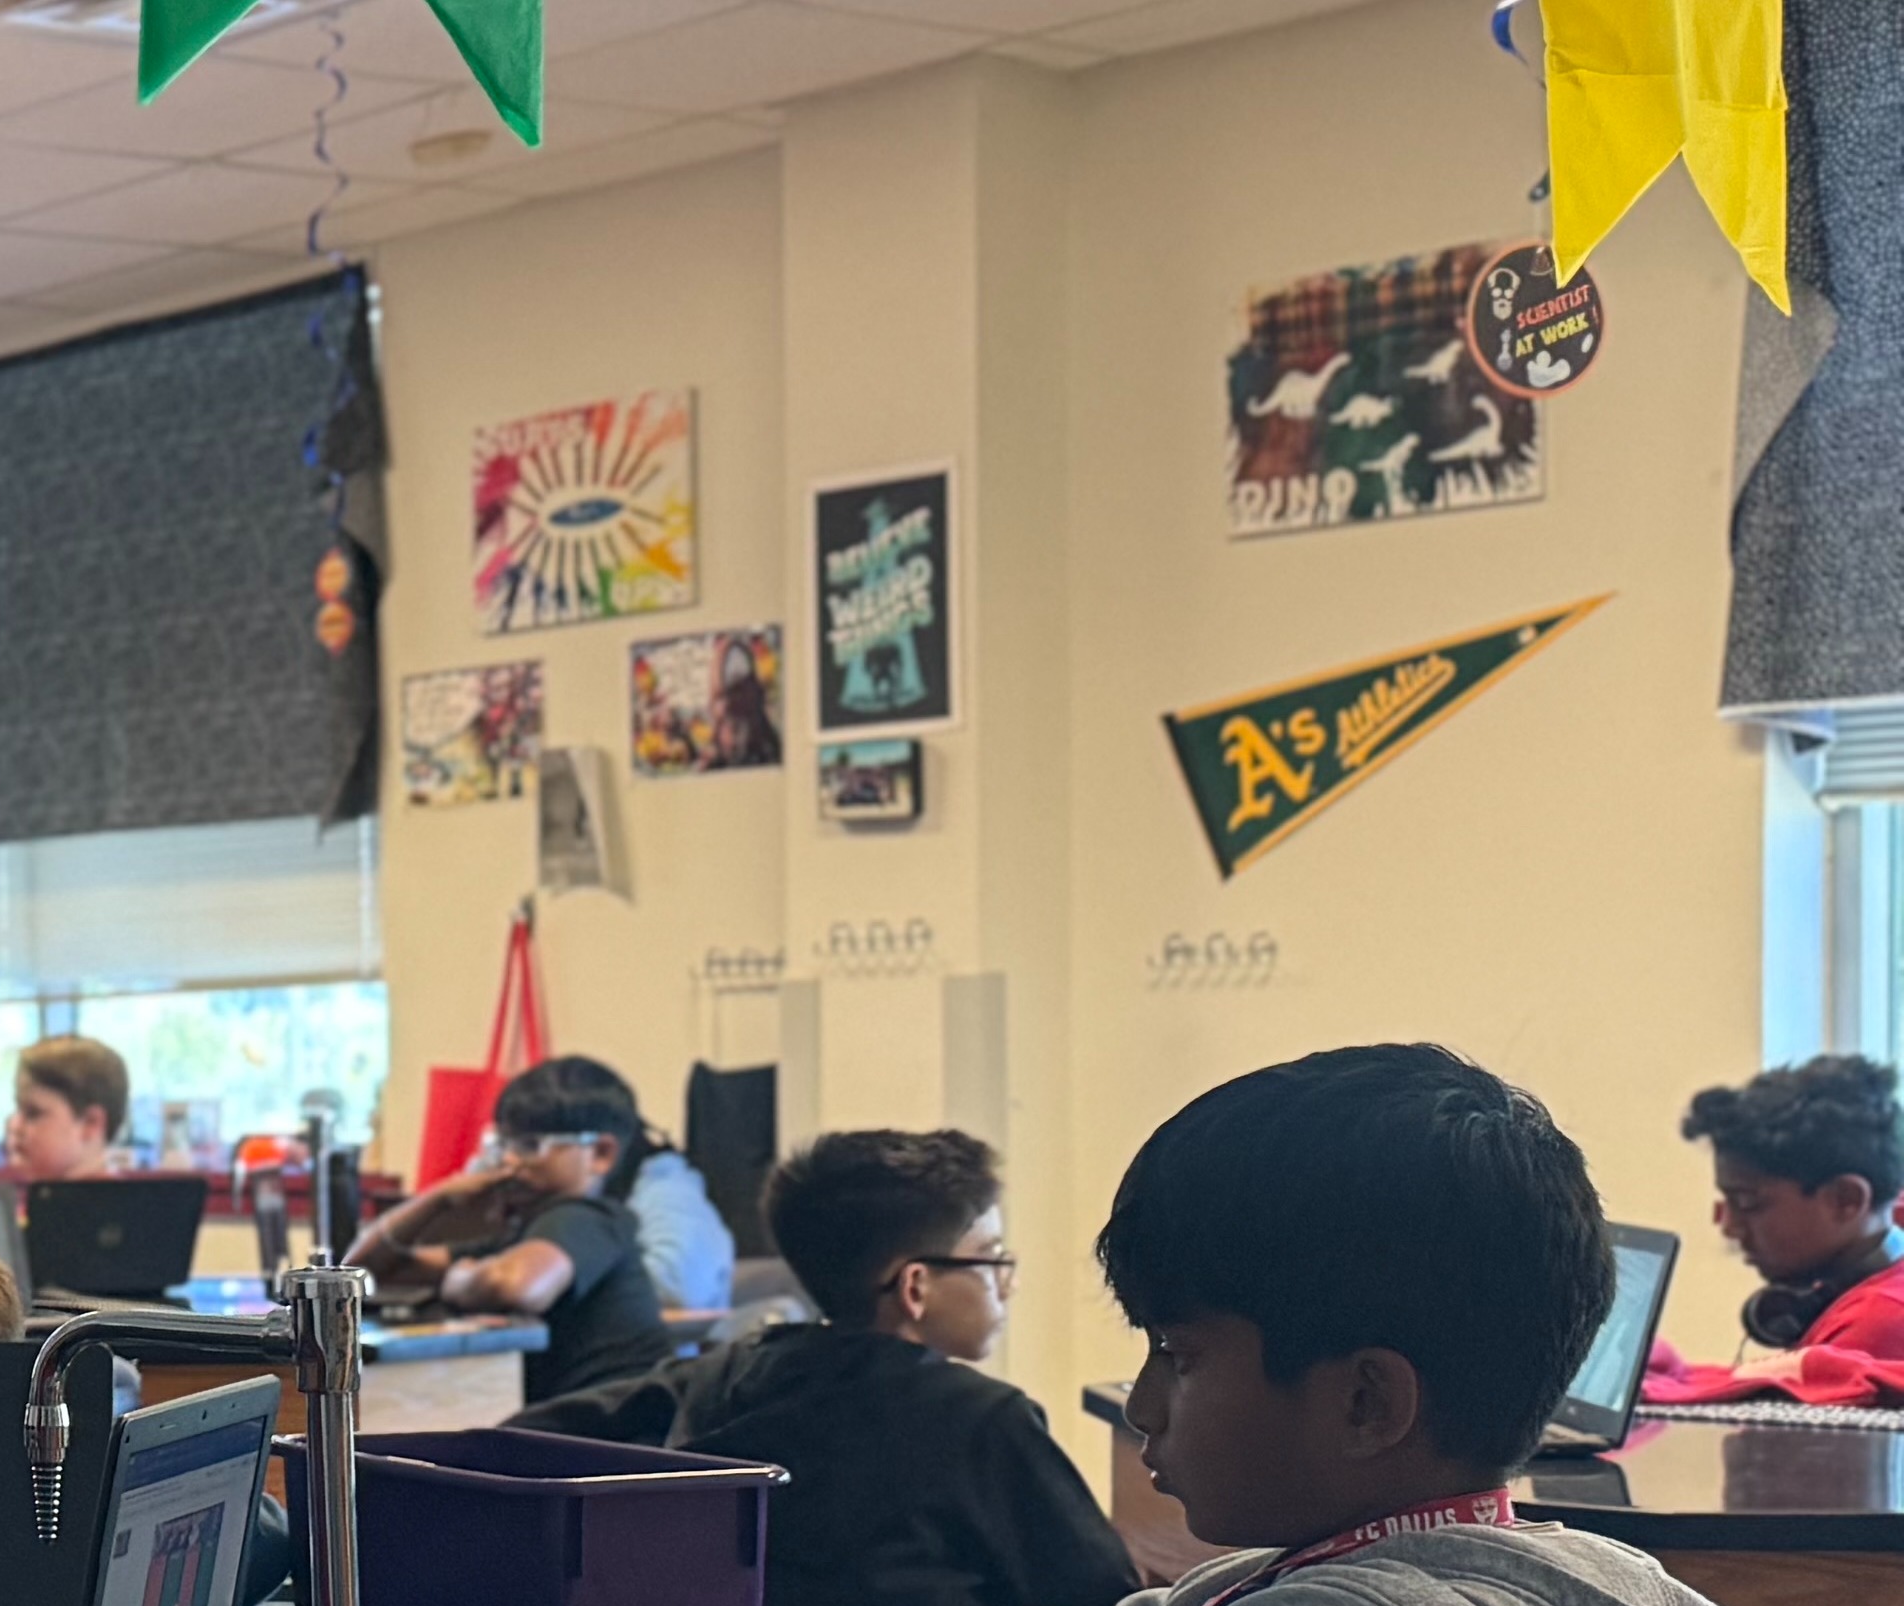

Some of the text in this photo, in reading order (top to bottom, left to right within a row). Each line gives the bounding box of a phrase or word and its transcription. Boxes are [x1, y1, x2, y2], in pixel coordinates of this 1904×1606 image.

[1515, 284, 1591, 330] SCIENTIST
[1514, 333, 1535, 358] AT
[1219, 706, 1327, 833] A's
[1384, 1507, 1458, 1537] DALLAS
